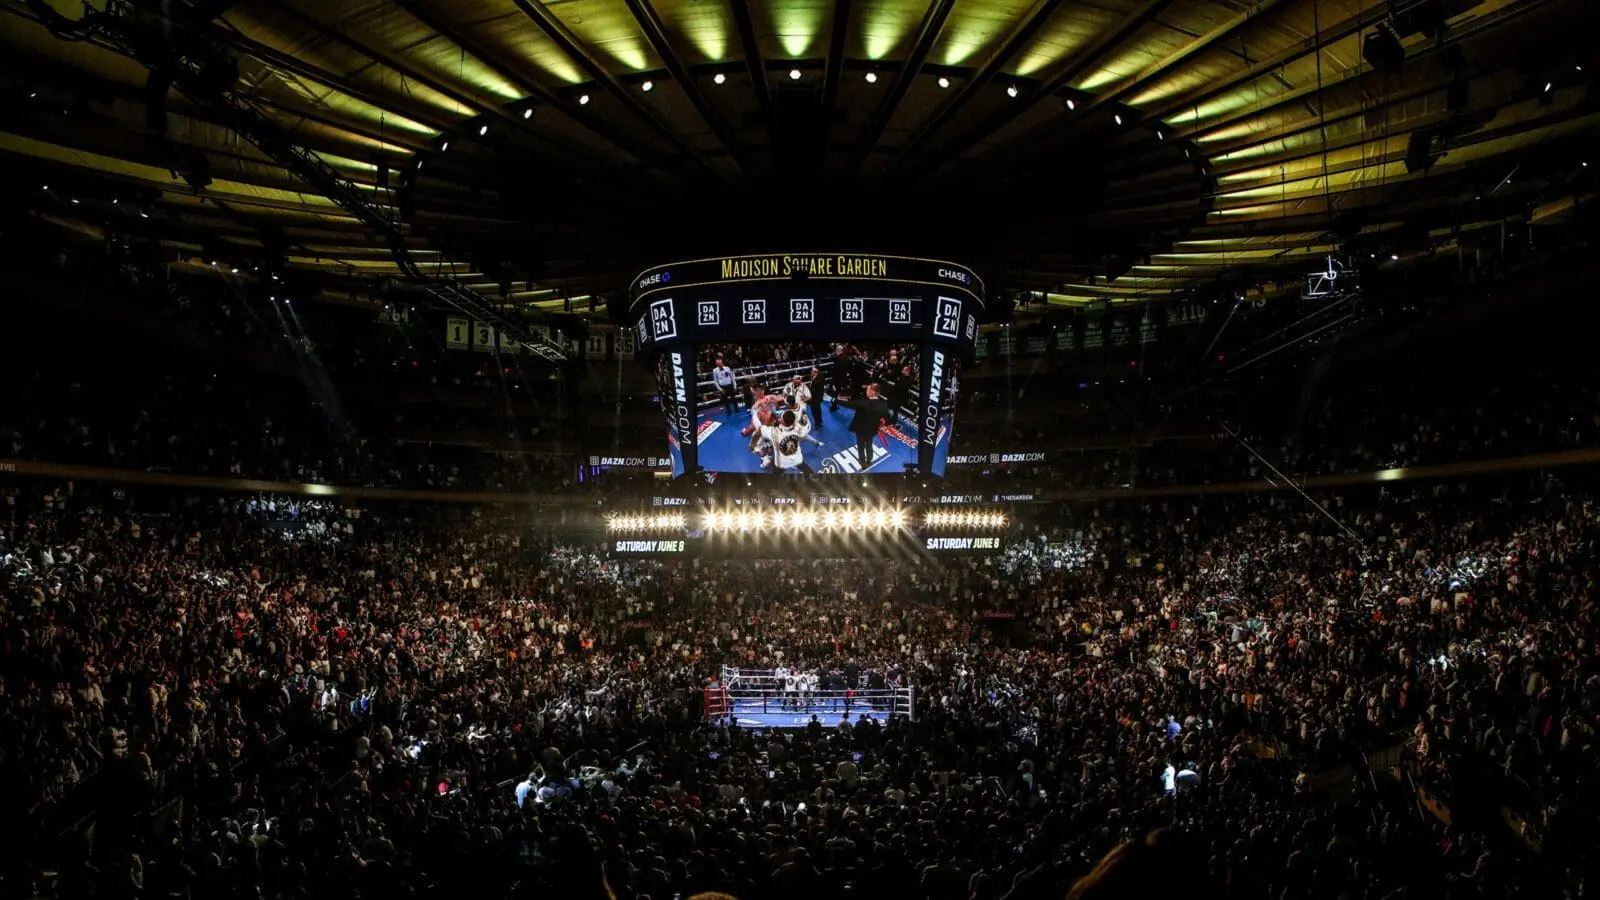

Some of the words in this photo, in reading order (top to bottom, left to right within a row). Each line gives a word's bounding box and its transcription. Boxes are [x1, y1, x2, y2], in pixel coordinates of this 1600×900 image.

[721, 259, 779, 278] MADISON
[837, 256, 887, 276] GARDEN
[640, 274, 661, 288] CHASE
[938, 268, 966, 283] CHASE
[454, 326, 461, 341] 1
[480, 328, 489, 344] 3
[671, 352, 692, 444] DAZN.COM
[924, 350, 945, 446] DAZN.COM
[601, 457, 645, 466] DAZN.COM
[1001, 453, 1045, 462] DAZN.COM
[616, 540, 657, 552] SATURDAY
[657, 540, 678, 552] JUNE
[678, 540, 685, 552] 8
[926, 537, 972, 549] SATURDAY
[973, 537, 993, 549] JUNE
[993, 537, 1000, 549] 8
